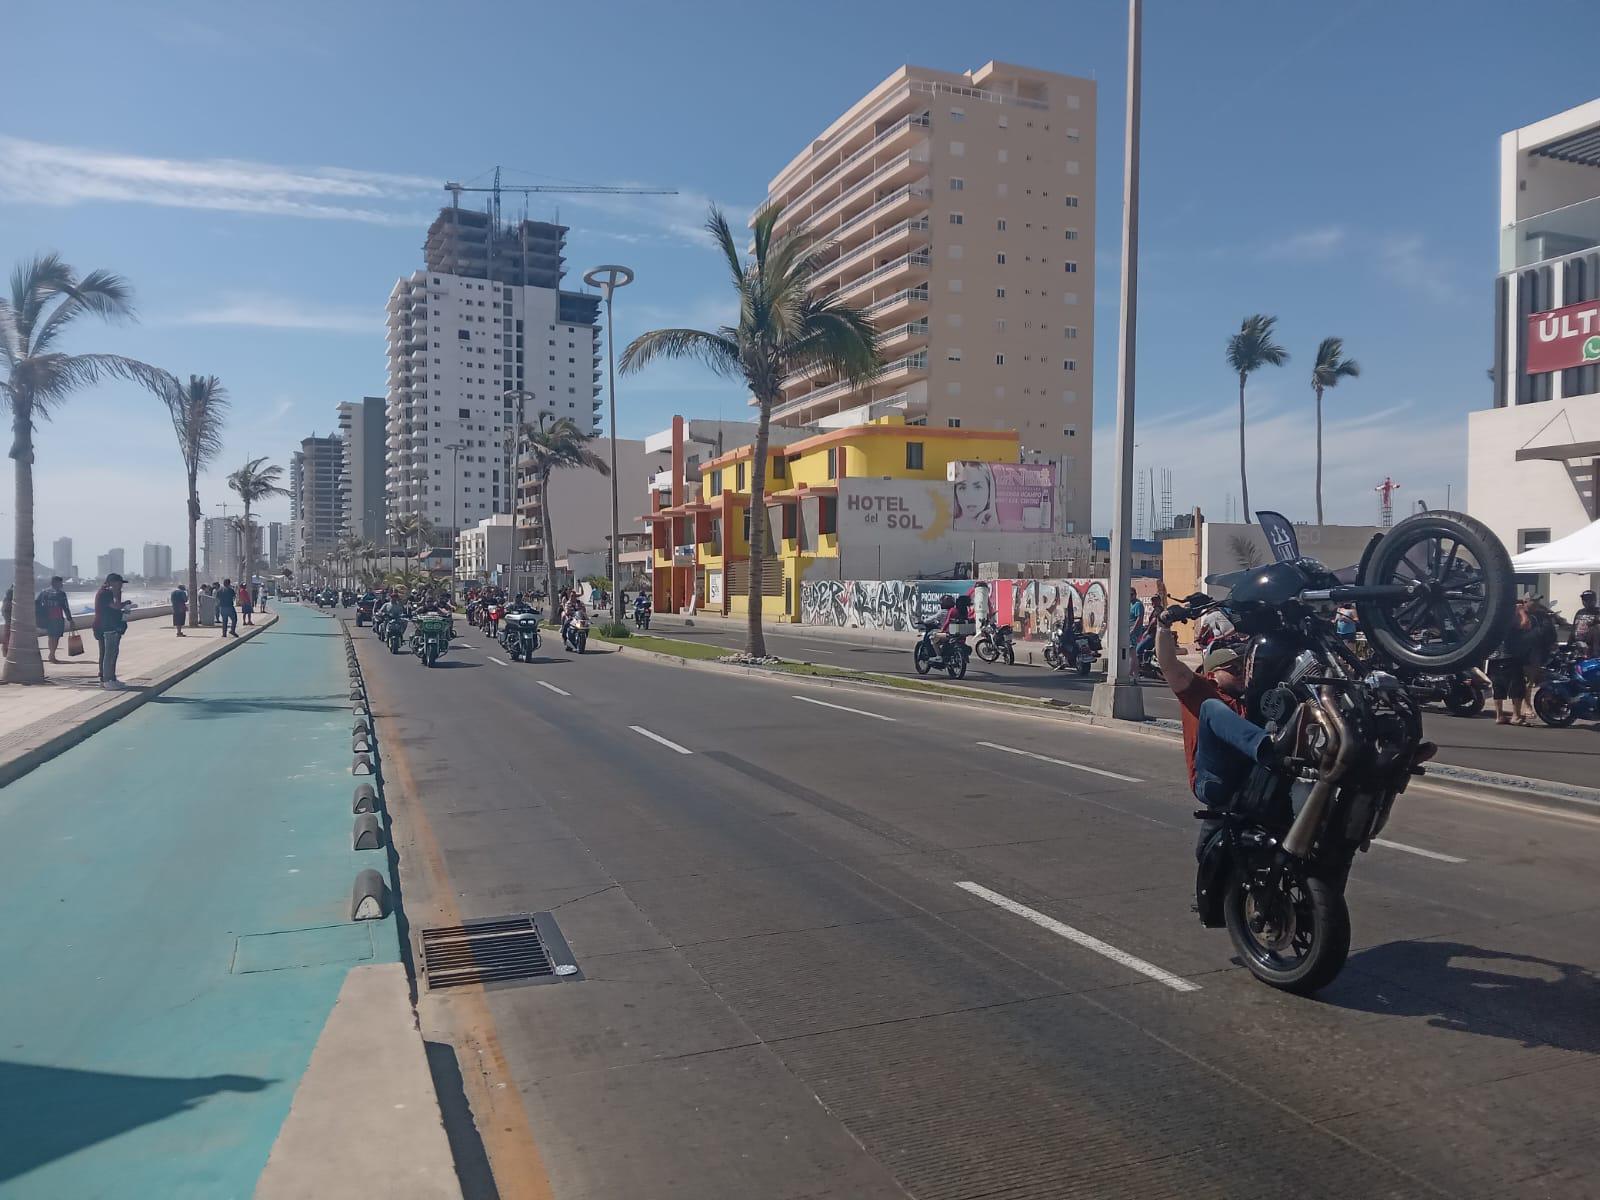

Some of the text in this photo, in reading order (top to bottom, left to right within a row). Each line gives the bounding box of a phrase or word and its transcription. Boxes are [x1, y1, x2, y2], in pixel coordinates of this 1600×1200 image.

[1539, 309, 1600, 342] ÚLT
[848, 495, 910, 512] HOTEL
[864, 513, 923, 529] del SOL
